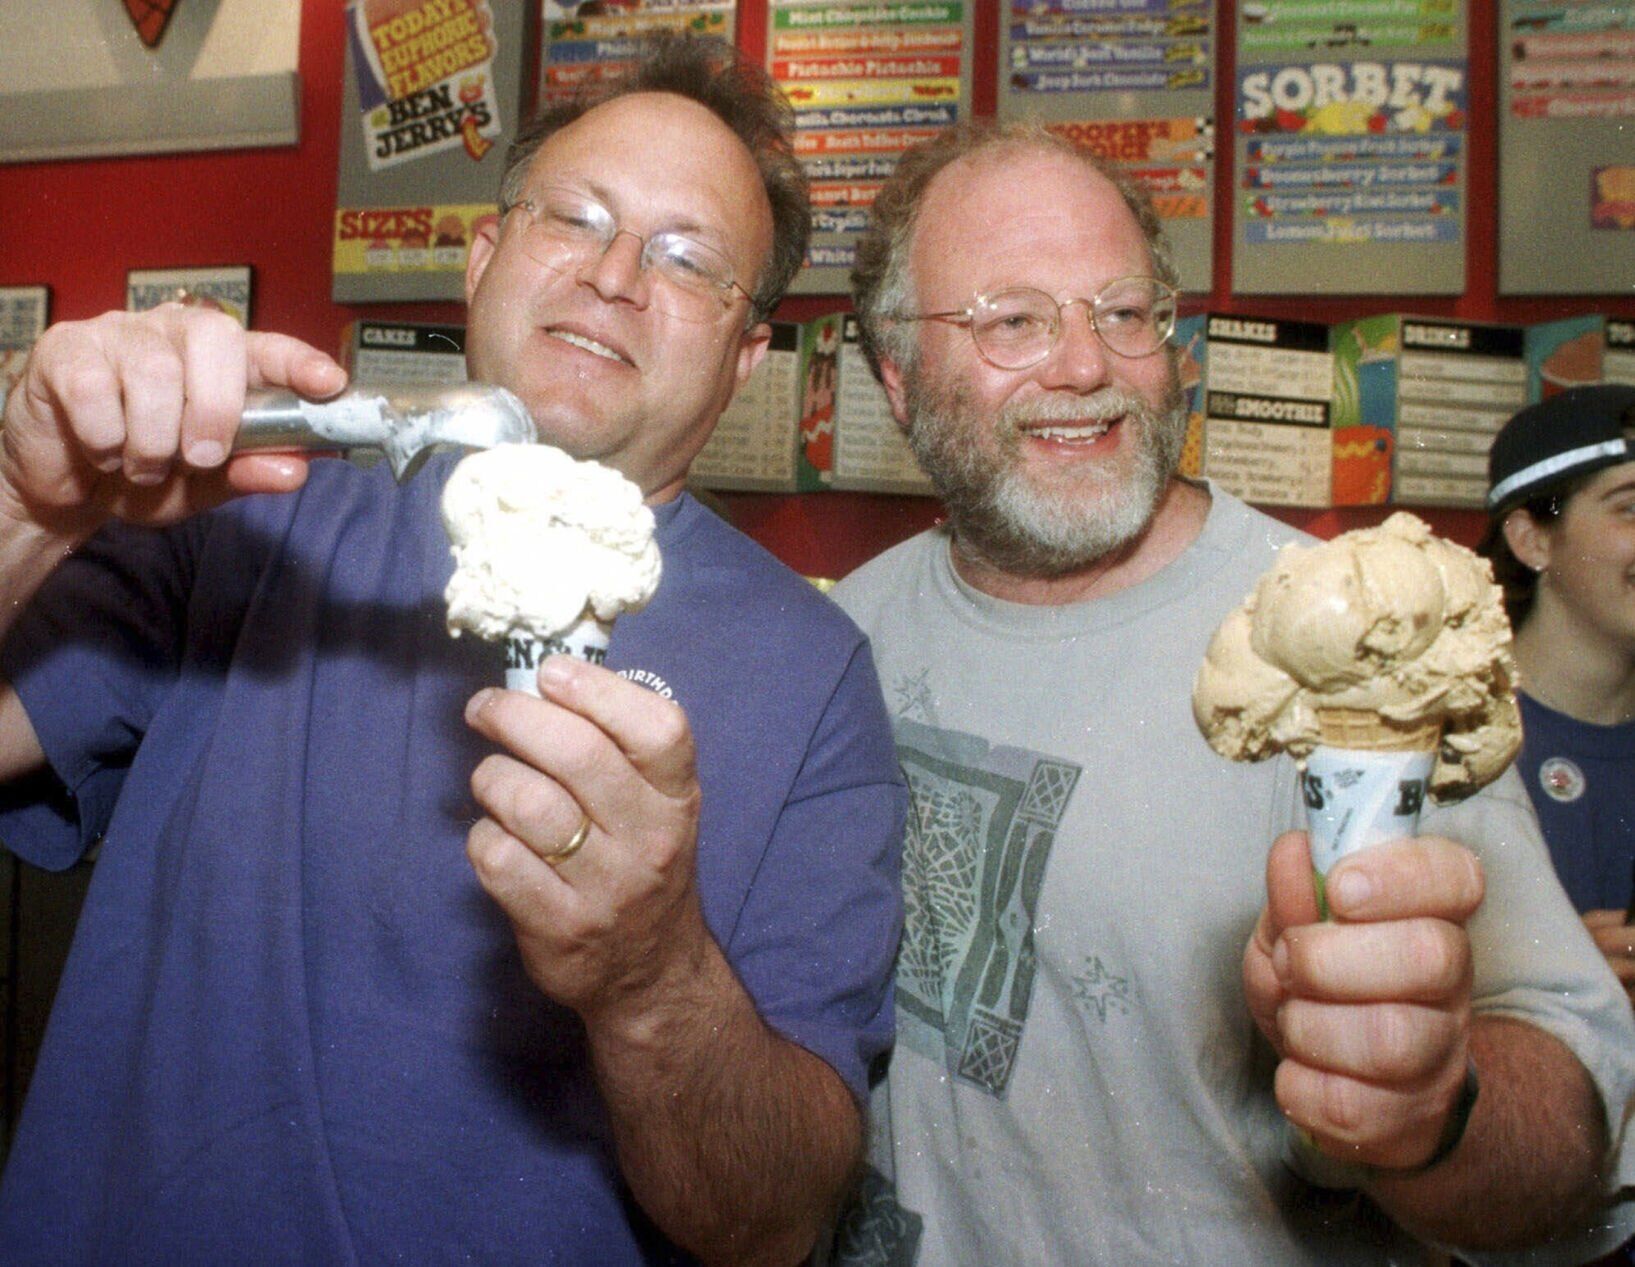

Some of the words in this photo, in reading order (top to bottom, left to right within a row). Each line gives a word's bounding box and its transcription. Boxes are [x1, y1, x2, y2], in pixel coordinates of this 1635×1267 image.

[387, 33, 489, 100] FLAVORS
[788, 60, 864, 77] Pistachio
[865, 59, 942, 77] Pistachio
[387, 84, 453, 126] BEN
[1242, 62, 1462, 120] SORBET
[376, 102, 491, 158] JERRY'S
[340, 208, 434, 240] SIZES
[363, 327, 417, 346] CAKES
[1208, 318, 1278, 342] SHAKES
[1234, 398, 1326, 423] SMOOTHIE
[617, 669, 678, 704] BIRTHD
